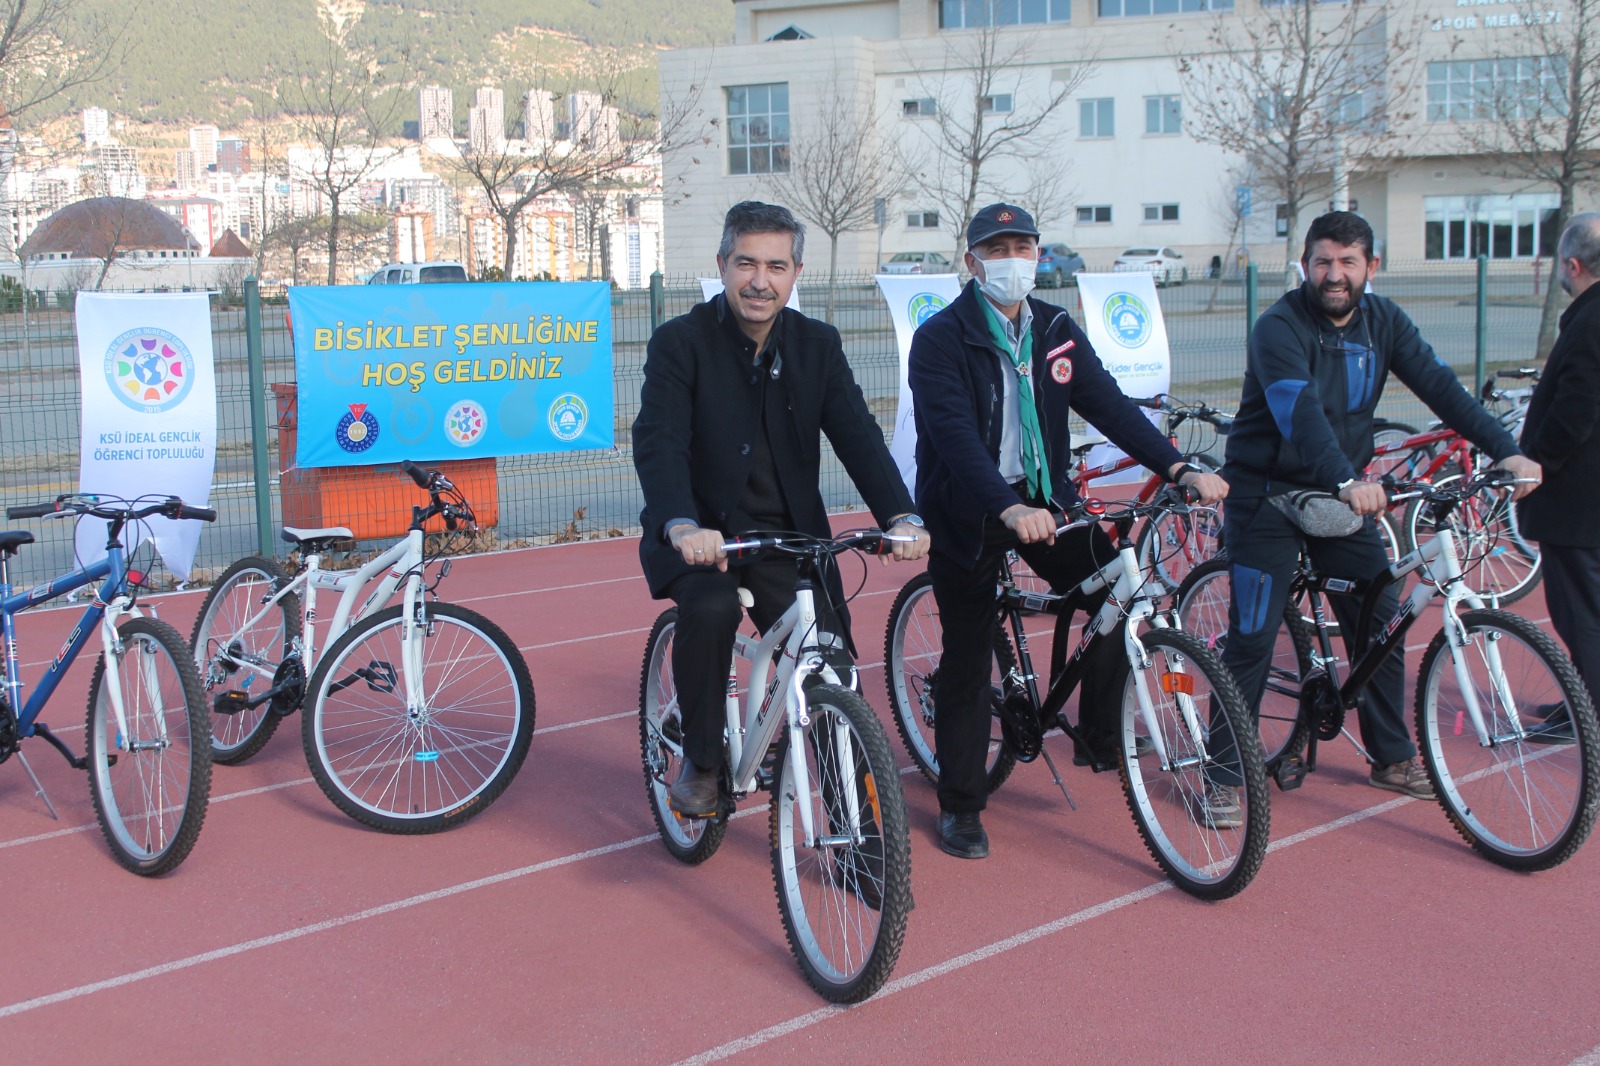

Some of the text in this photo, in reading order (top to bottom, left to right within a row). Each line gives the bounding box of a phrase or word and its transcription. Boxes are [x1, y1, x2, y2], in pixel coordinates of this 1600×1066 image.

[313, 314, 599, 354] BİSİKLET ŞENLİĞİNE
[362, 350, 563, 393] HOŞ GELDİNİZ
[144, 405, 161, 413] 2015
[100, 429, 201, 445] KSÜ İDEAL GENÇLİK
[94, 446, 205, 461] ÖĞRENCİ TOPLULUĞU
